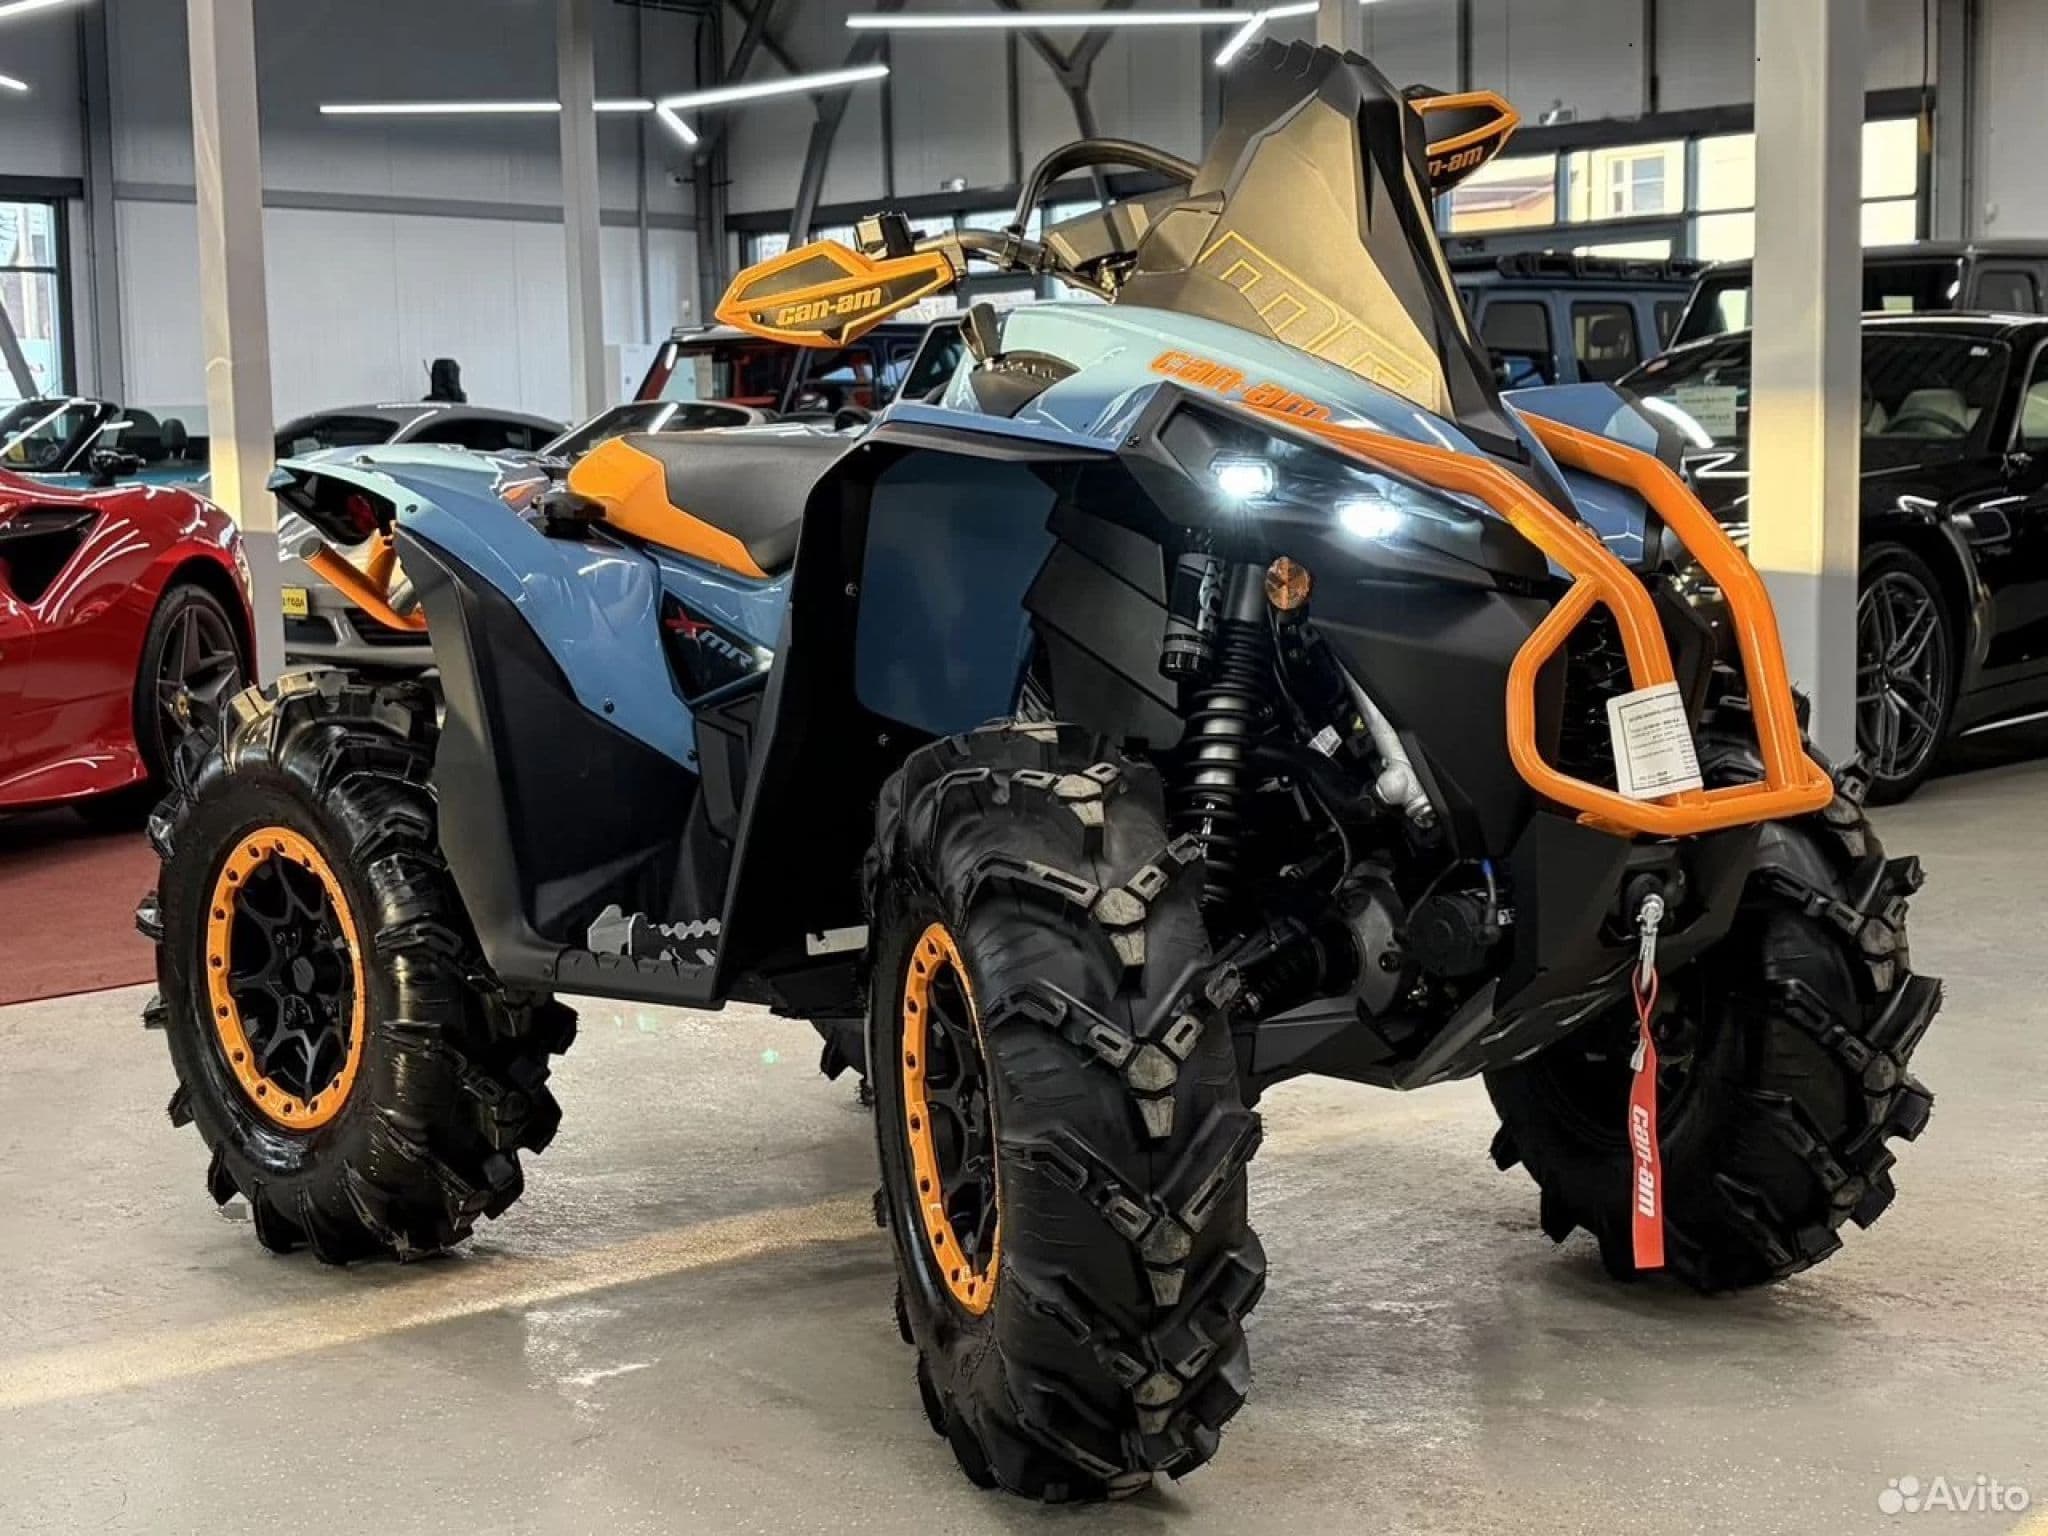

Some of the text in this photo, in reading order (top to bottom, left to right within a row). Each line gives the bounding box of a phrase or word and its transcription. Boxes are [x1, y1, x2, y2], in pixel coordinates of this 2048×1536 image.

[1427, 145, 1483, 176] n-am
[775, 287, 882, 327] can-am
[1150, 350, 1332, 422] can-am
[1633, 1103, 1656, 1218] can-am
